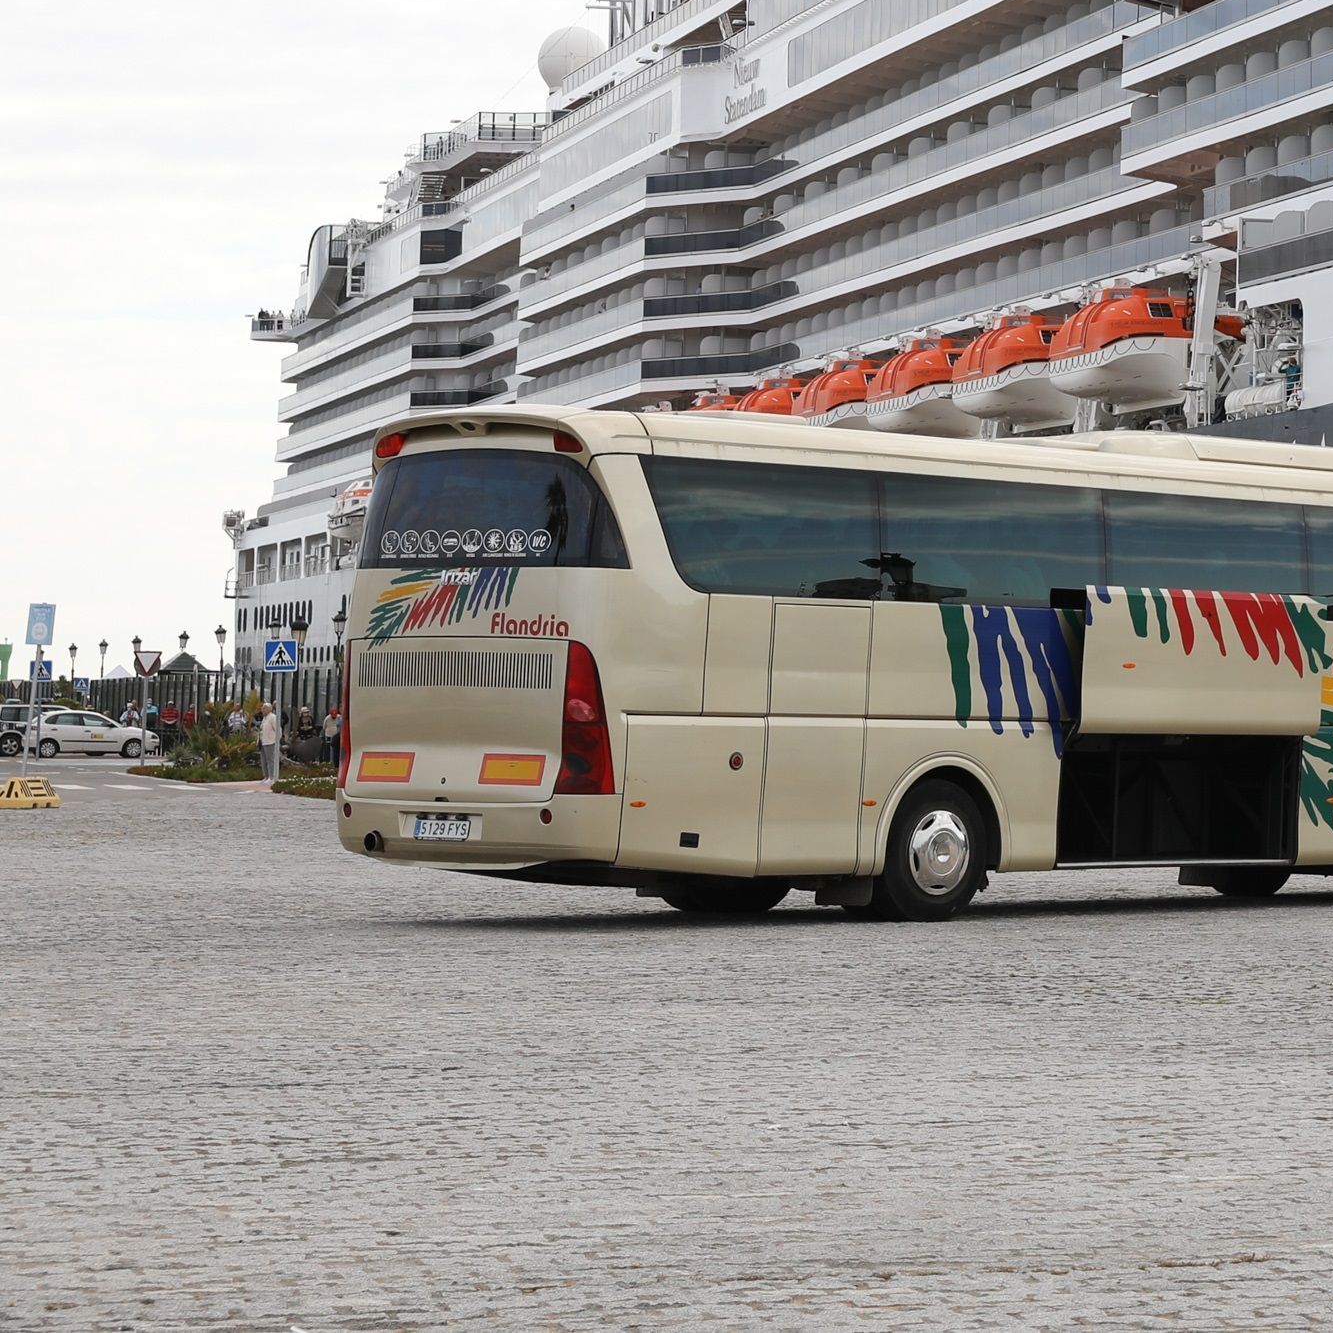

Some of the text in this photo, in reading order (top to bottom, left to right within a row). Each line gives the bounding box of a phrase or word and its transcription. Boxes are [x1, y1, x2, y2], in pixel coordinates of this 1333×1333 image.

[532, 534, 547, 548] WC
[440, 569, 478, 586] Irizar
[490, 612, 570, 637] Flandria
[421, 822, 467, 836] 5129 FYS
